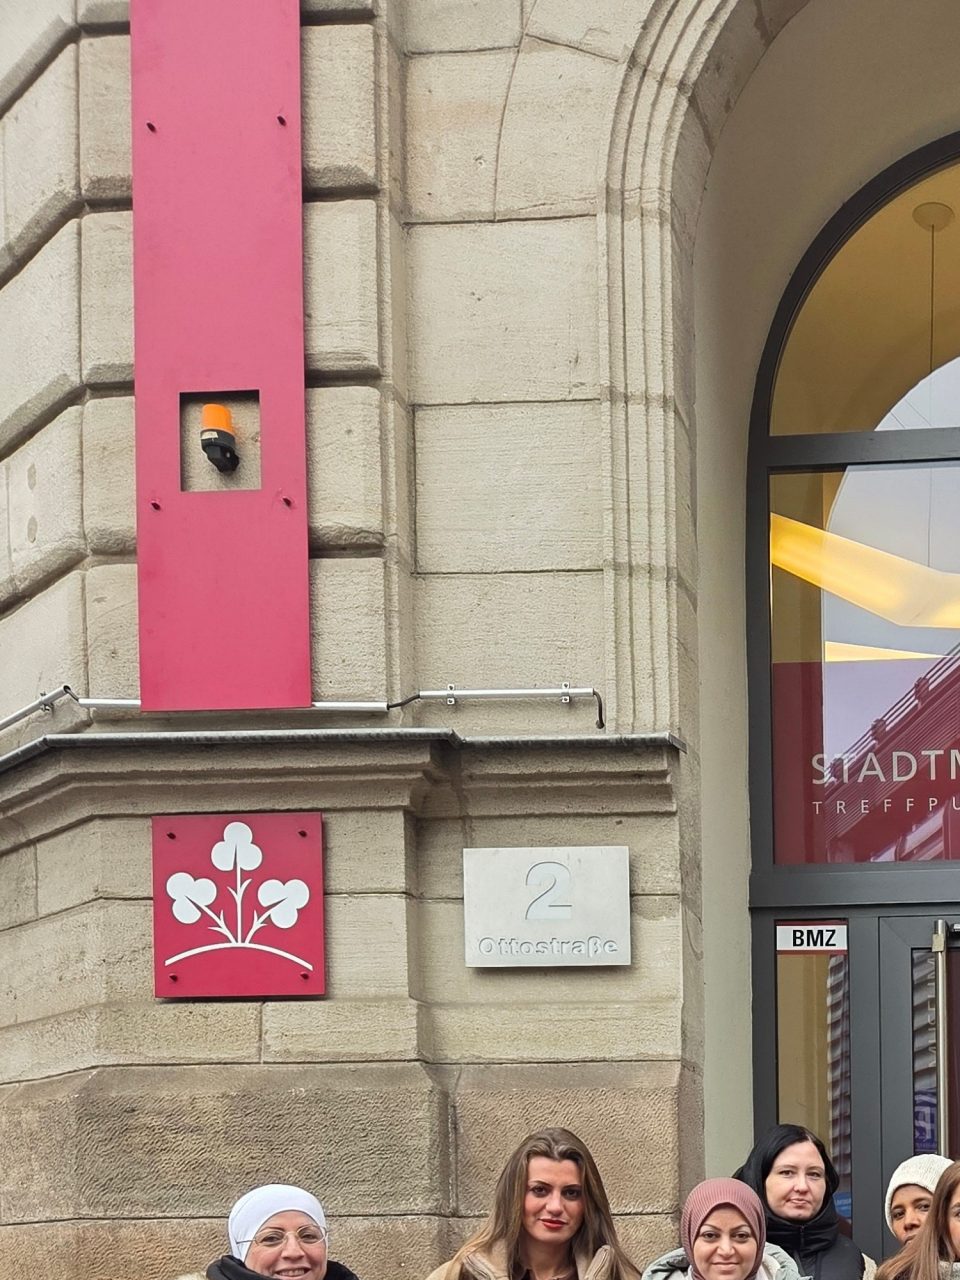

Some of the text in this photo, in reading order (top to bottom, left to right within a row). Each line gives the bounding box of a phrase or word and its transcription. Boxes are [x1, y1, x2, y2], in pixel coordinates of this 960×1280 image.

[525, 861, 573, 920] 2
[478, 935, 618, 958] Ottostraße
[792, 929, 837, 947] BMZ
